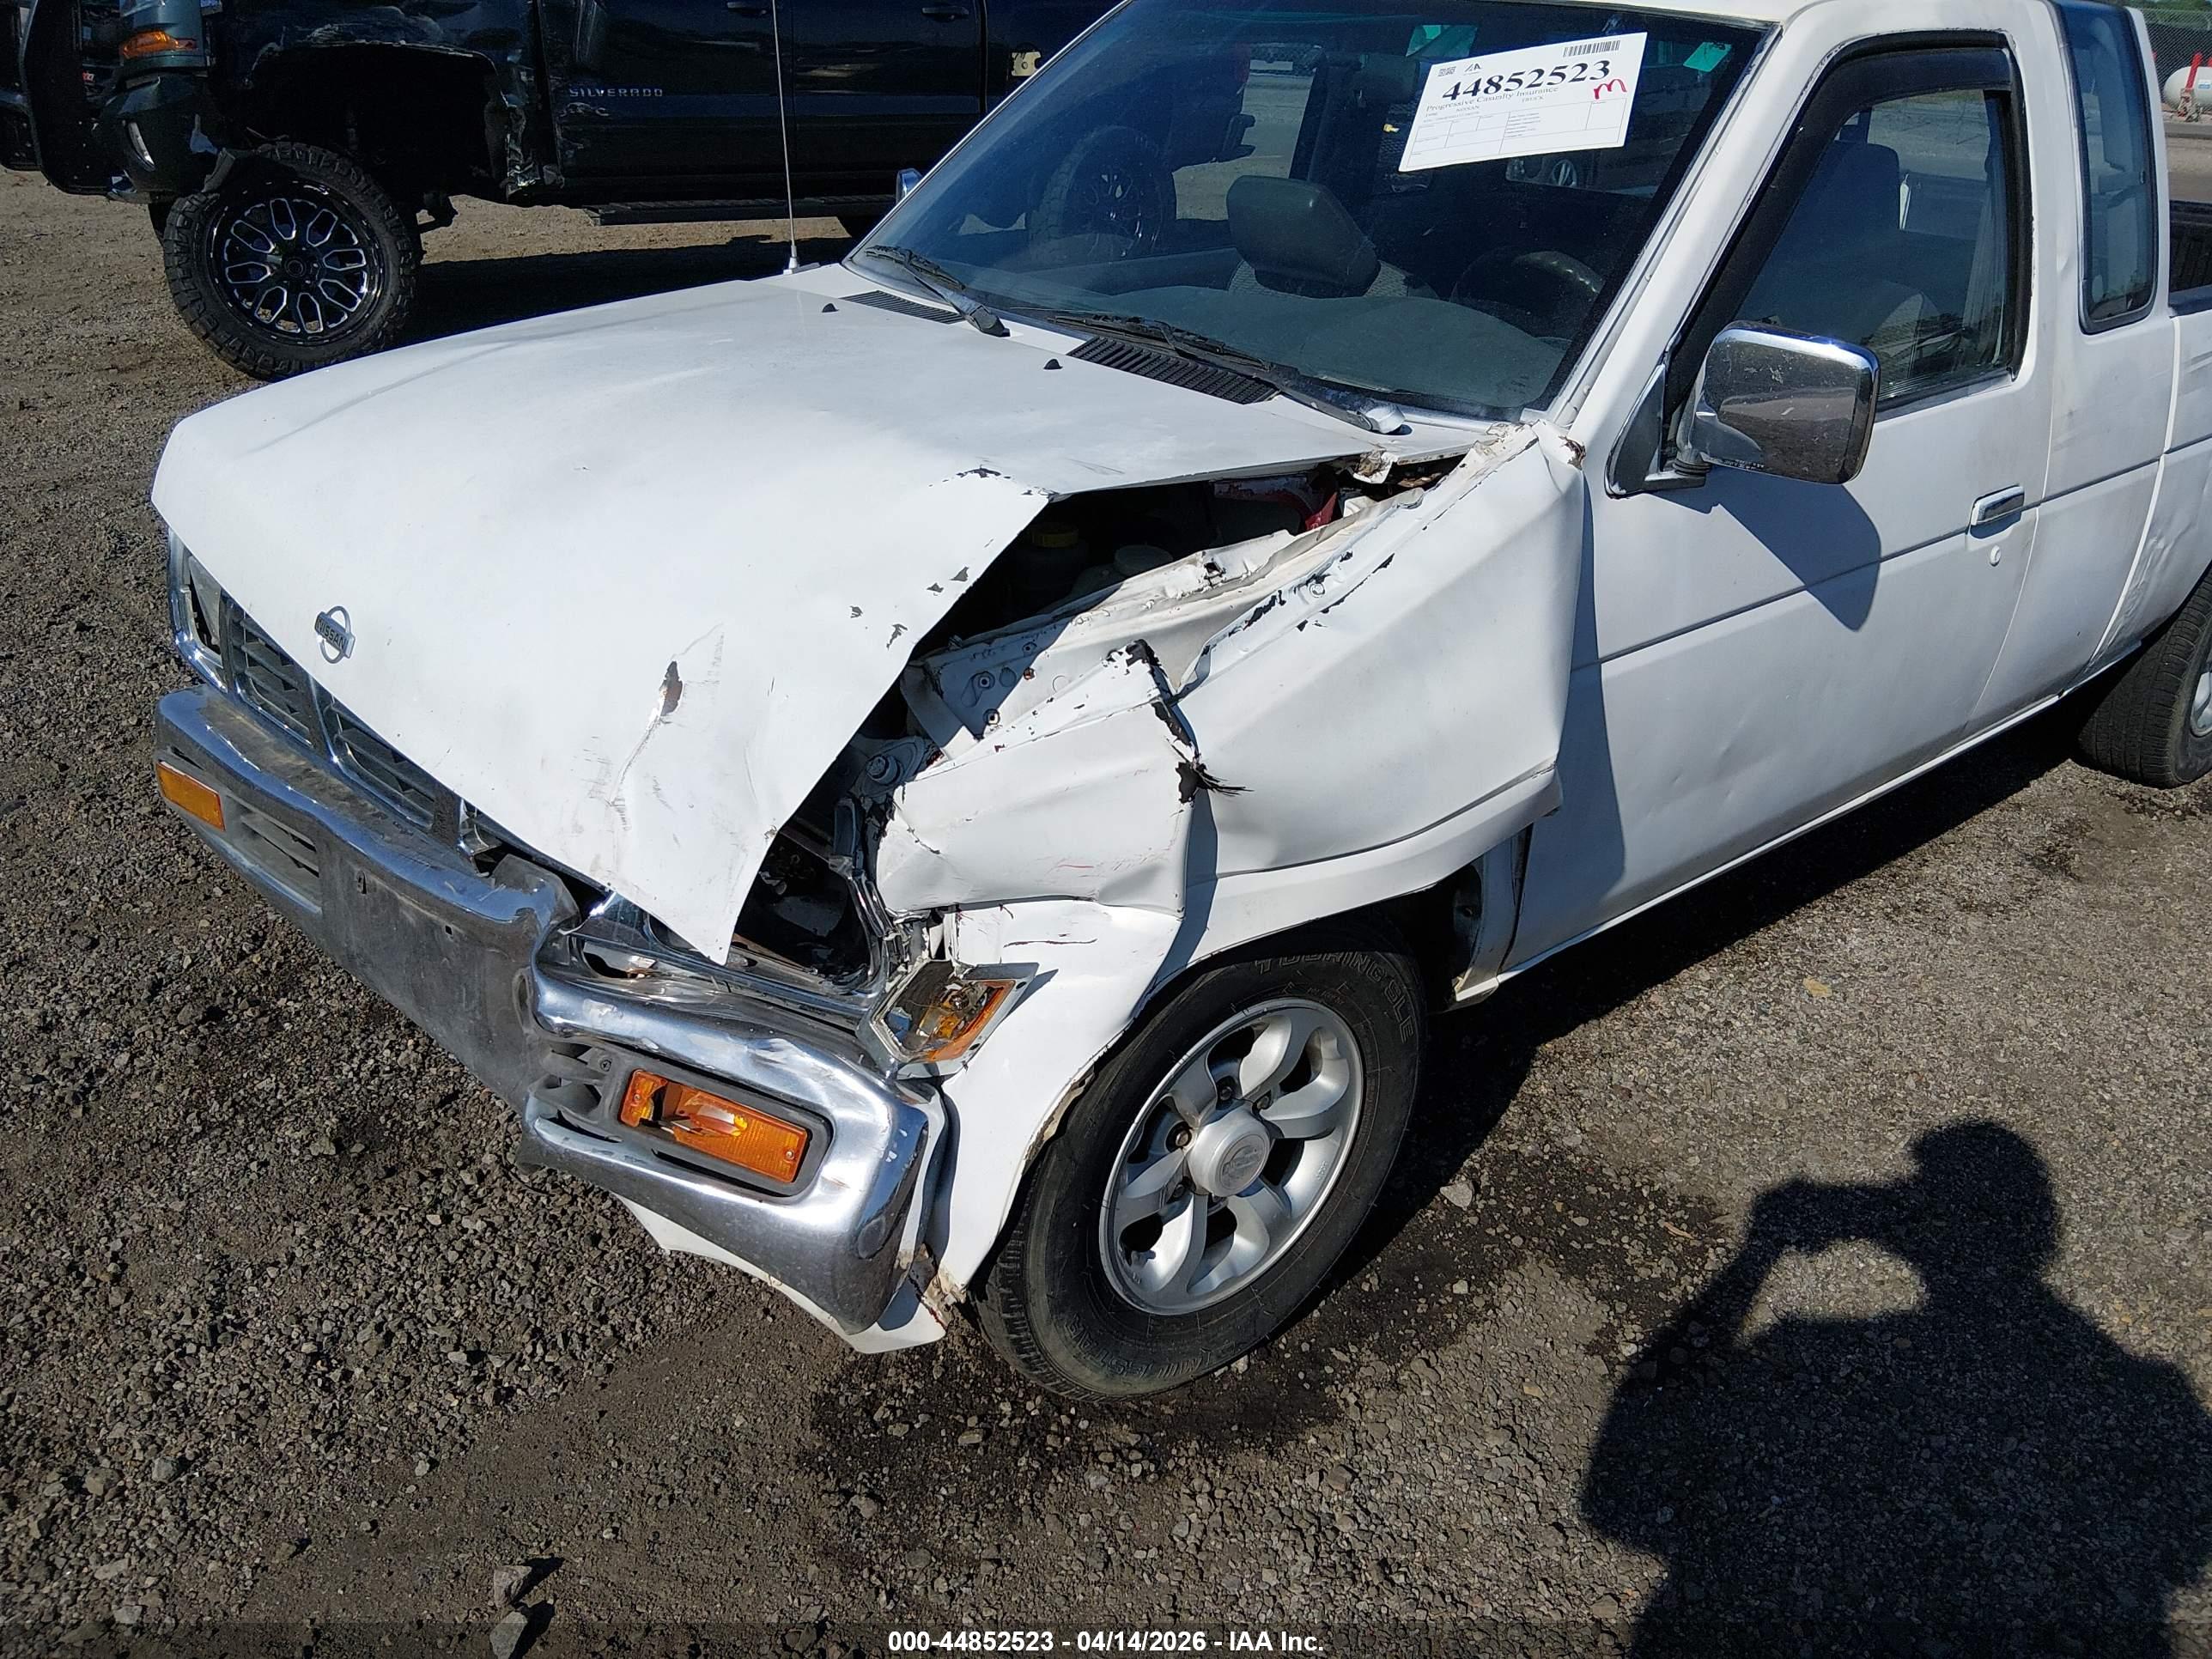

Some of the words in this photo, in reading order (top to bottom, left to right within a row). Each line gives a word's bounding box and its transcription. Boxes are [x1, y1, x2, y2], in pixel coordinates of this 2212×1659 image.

[568, 88, 664, 97] SILVERADO
[1442, 59, 1611, 100] 44852523
[1426, 98, 1474, 112] Progressive
[1476, 92, 1514, 103] Casualty
[1516, 87, 1559, 97] Insurance
[316, 617, 347, 650] NISSAN
[1383, 978, 1415, 1044] SLE
